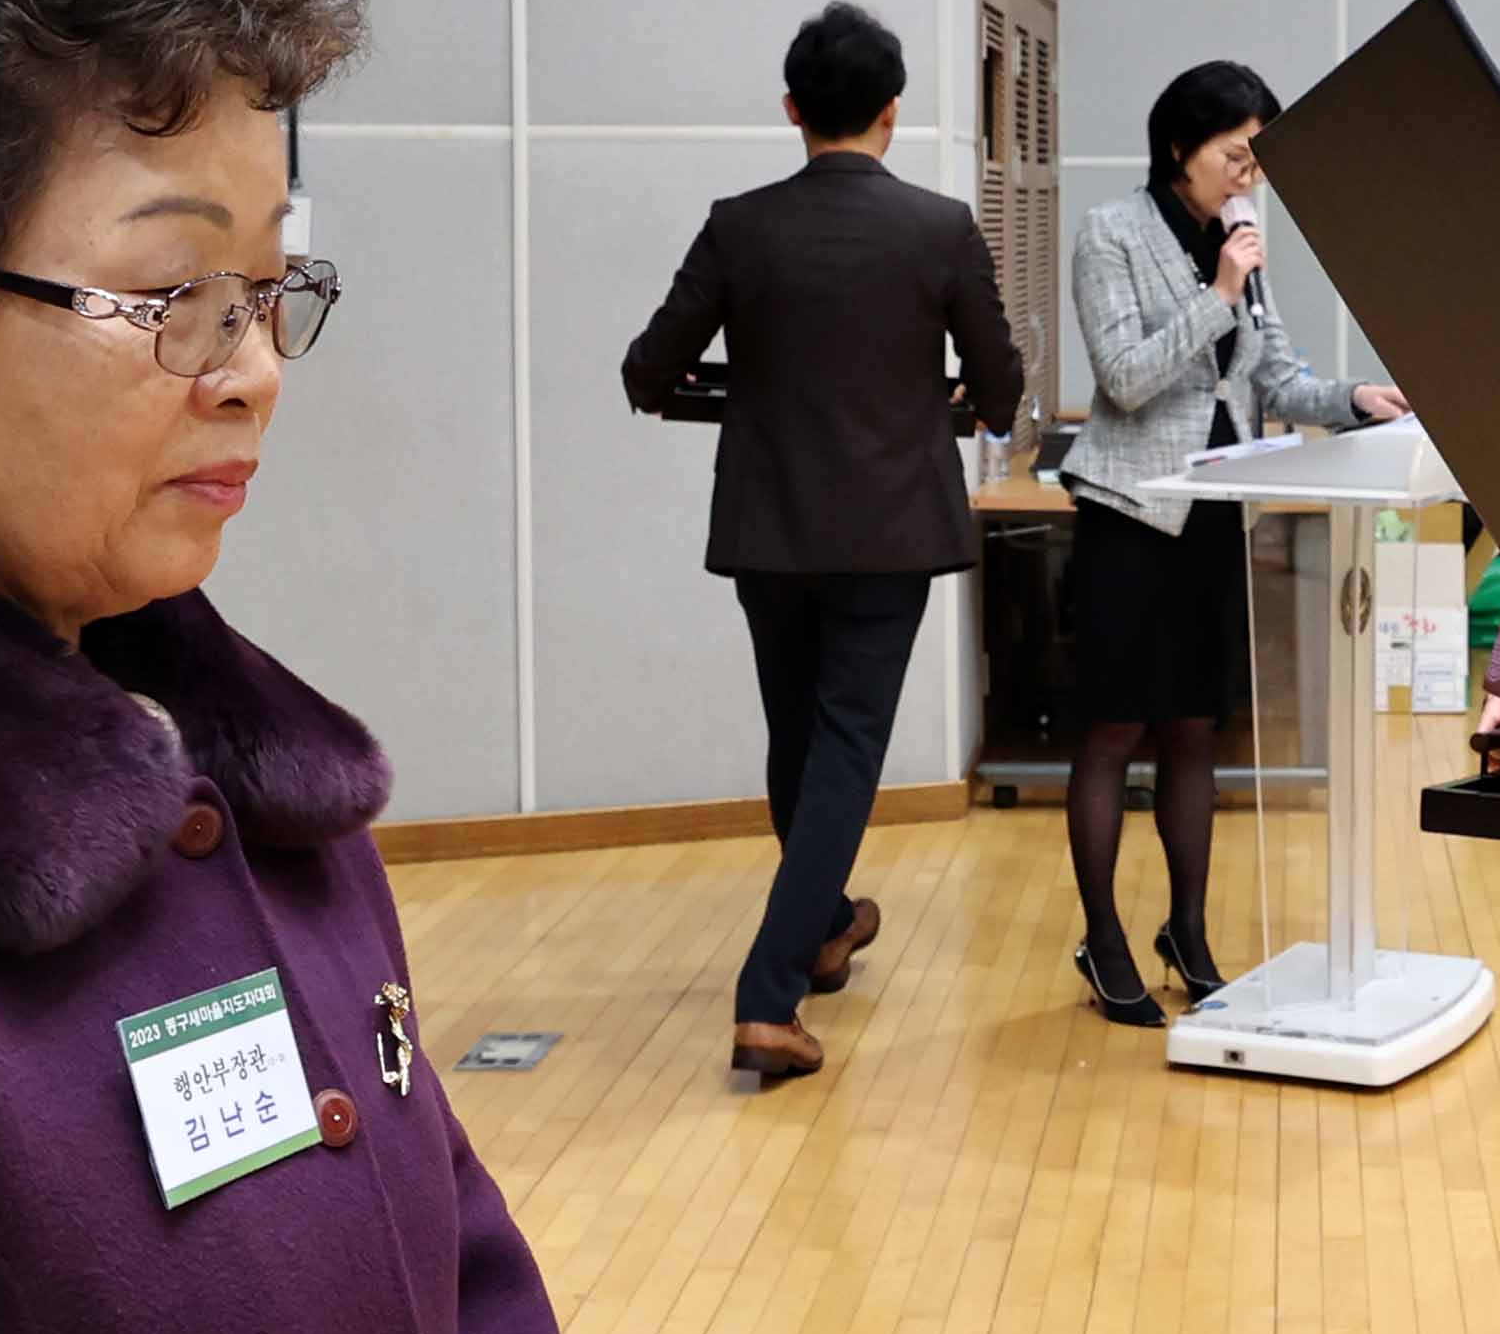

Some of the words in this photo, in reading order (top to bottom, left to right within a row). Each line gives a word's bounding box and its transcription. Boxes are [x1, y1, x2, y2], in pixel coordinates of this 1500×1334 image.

[128, 1023, 161, 1049] 2023
[164, 982, 277, 1037] 동구새마을지도자대회
[172, 1042, 269, 1103] 행안부장관
